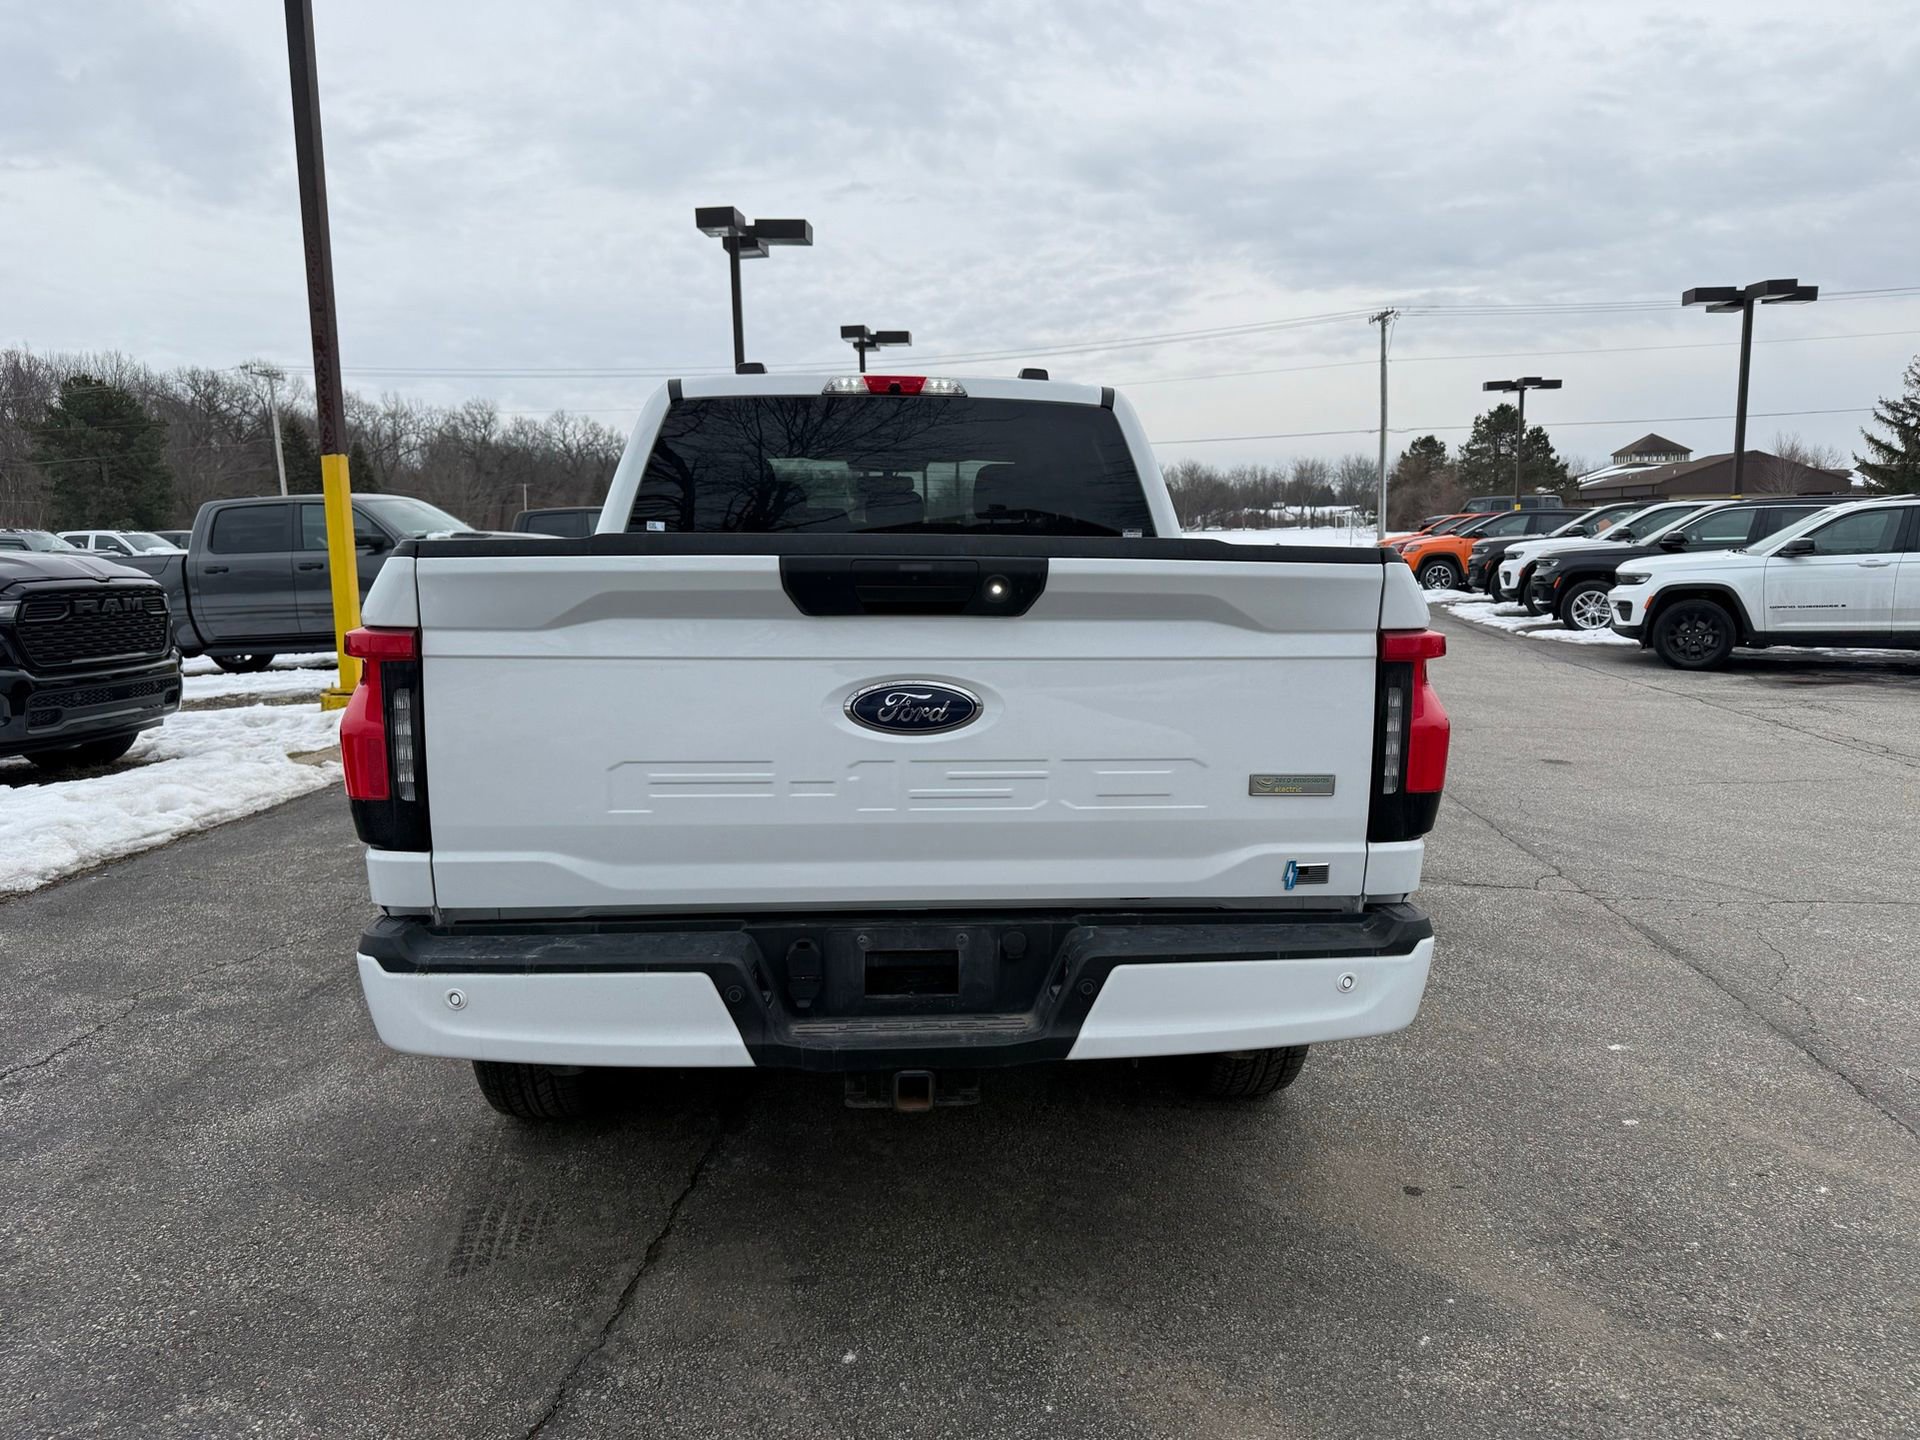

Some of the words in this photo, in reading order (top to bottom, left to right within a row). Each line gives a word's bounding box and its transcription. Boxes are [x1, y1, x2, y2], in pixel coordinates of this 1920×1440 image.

[74, 597, 144, 614] RAM
[877, 692, 951, 723] Ford
[606, 758, 1209, 814] F-150
[1274, 785, 1303, 793] electric
